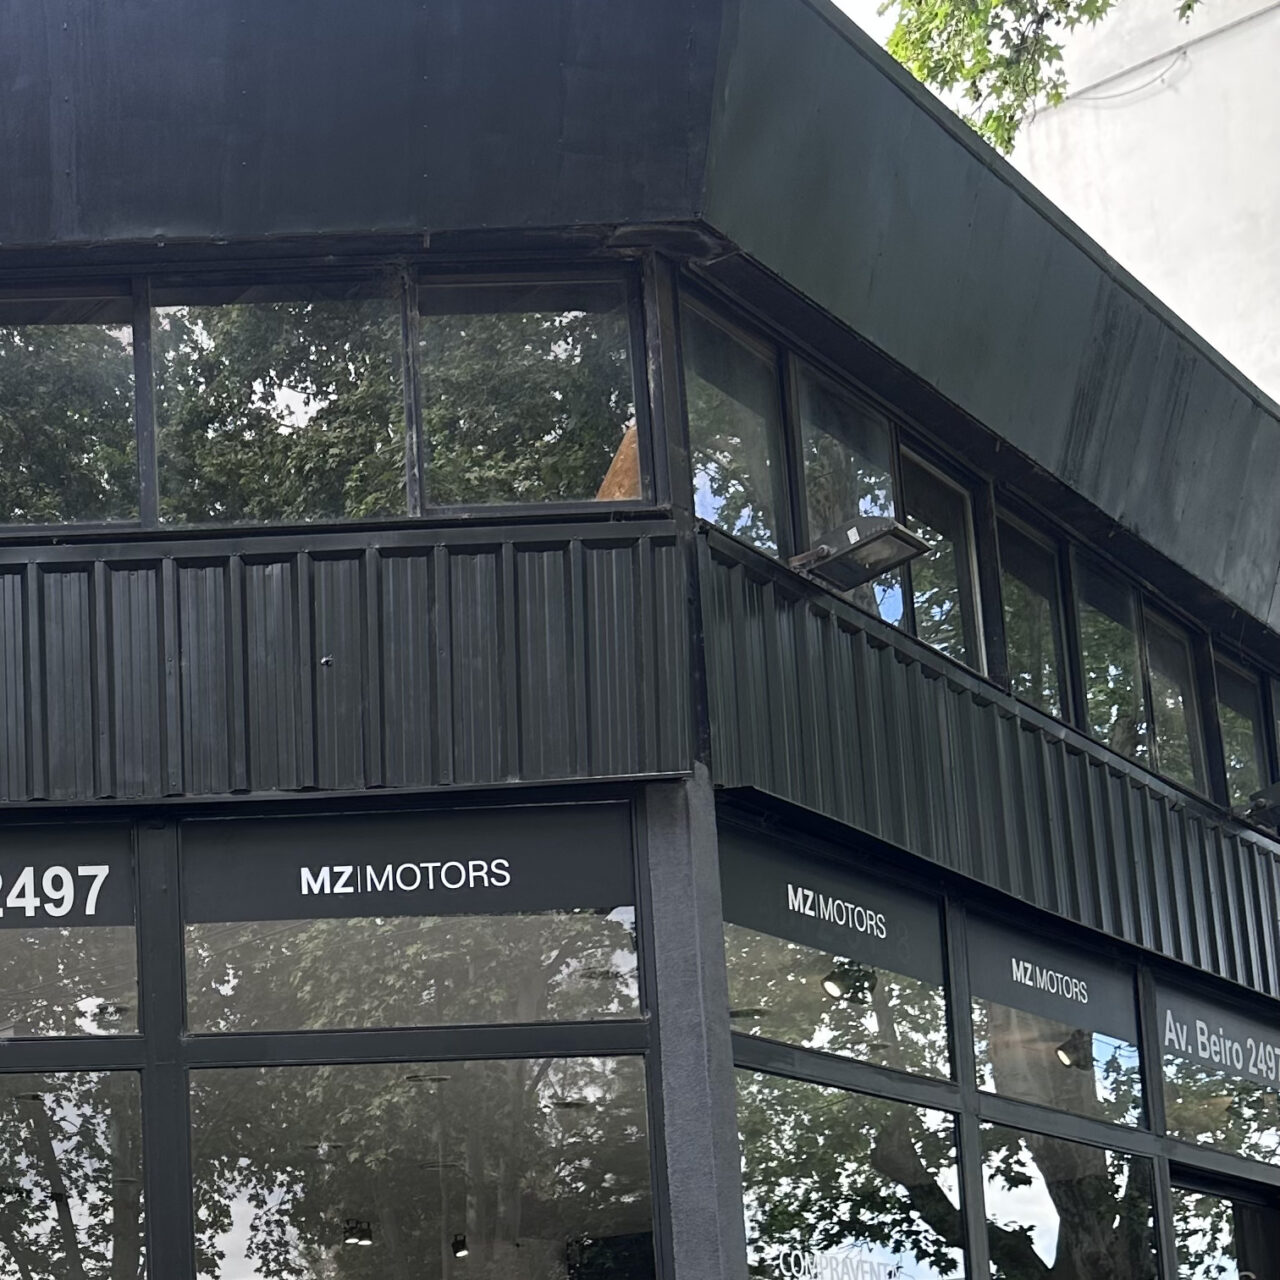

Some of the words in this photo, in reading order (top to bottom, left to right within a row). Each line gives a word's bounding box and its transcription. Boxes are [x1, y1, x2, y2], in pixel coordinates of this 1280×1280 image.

[365, 858, 511, 892] MOTORS
[819, 893, 887, 939] MOTORS
[1036, 968, 1089, 1004] MOTORS
[1164, 1009, 1193, 1054] Av.
[1195, 1019, 1243, 1070] Beiro
